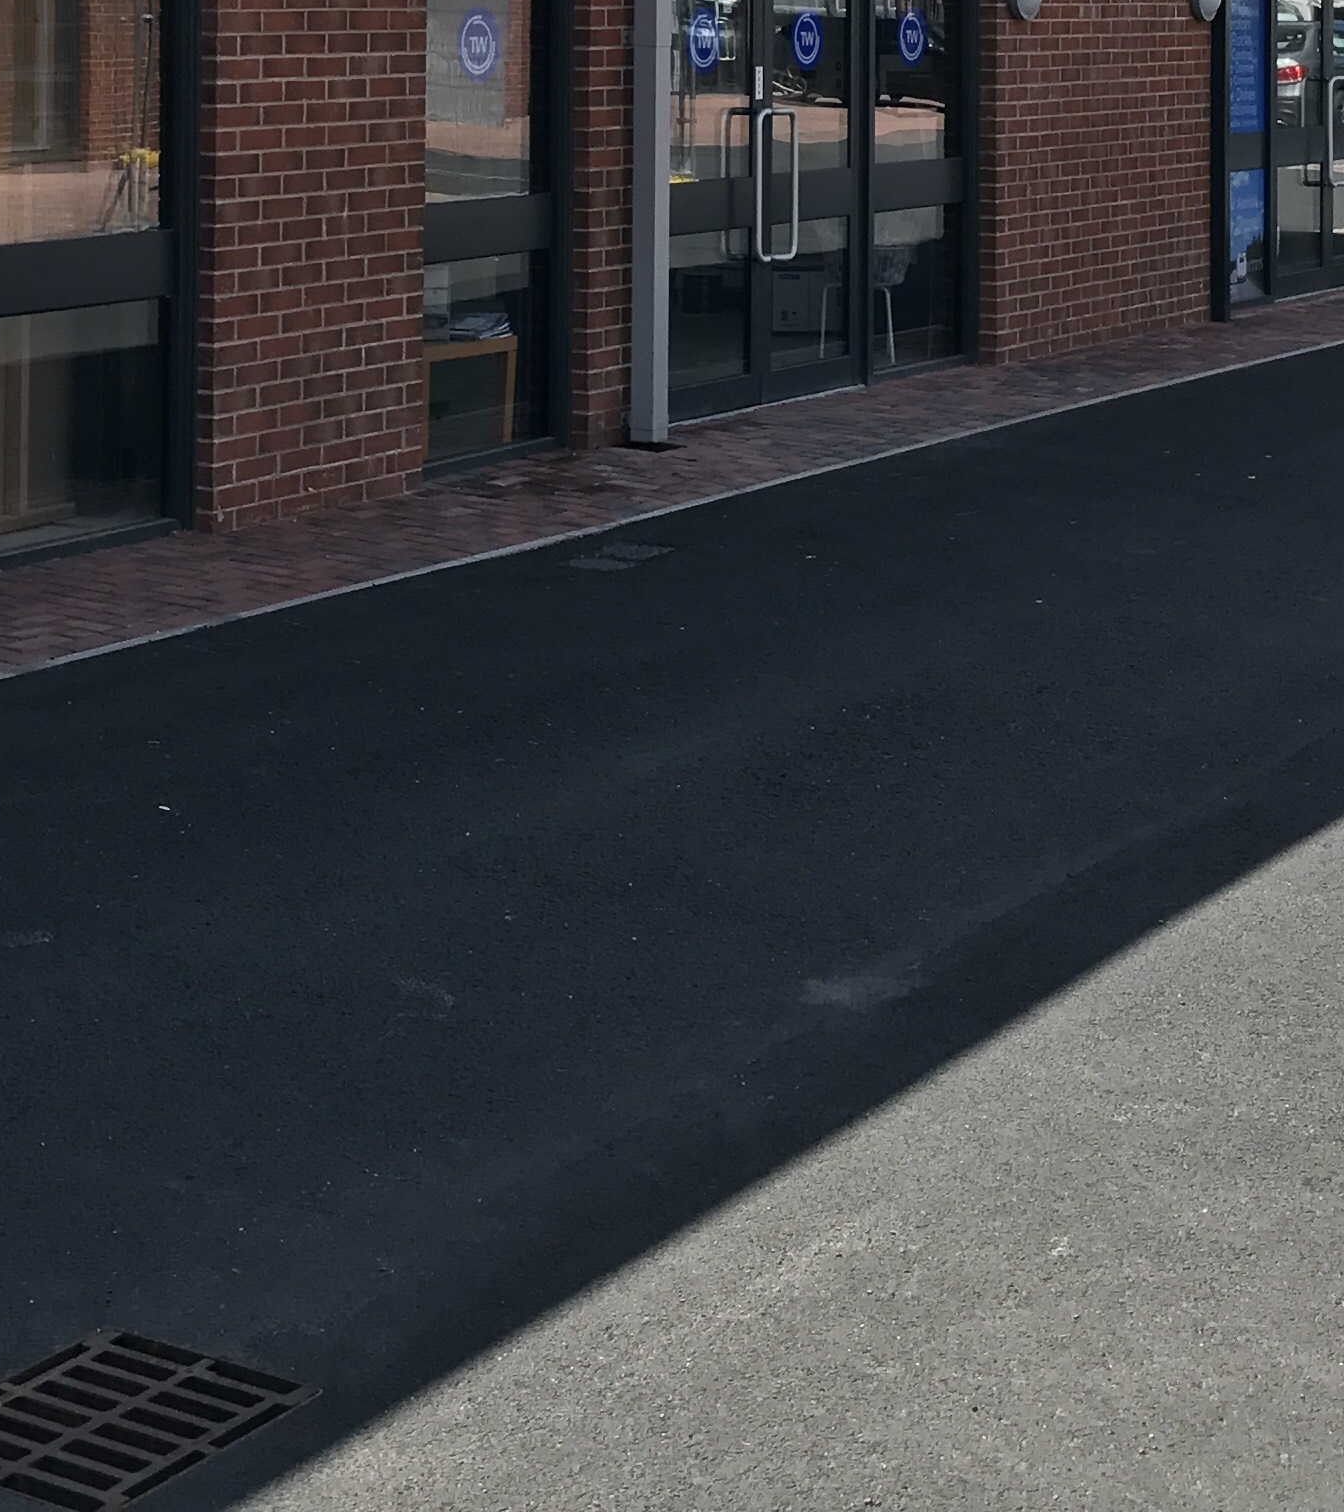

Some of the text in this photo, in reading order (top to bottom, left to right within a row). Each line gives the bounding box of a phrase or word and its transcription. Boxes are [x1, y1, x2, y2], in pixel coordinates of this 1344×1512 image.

[799, 32, 815, 47] TW
[905, 29, 918, 44] TW
[469, 36, 488, 54] TW
